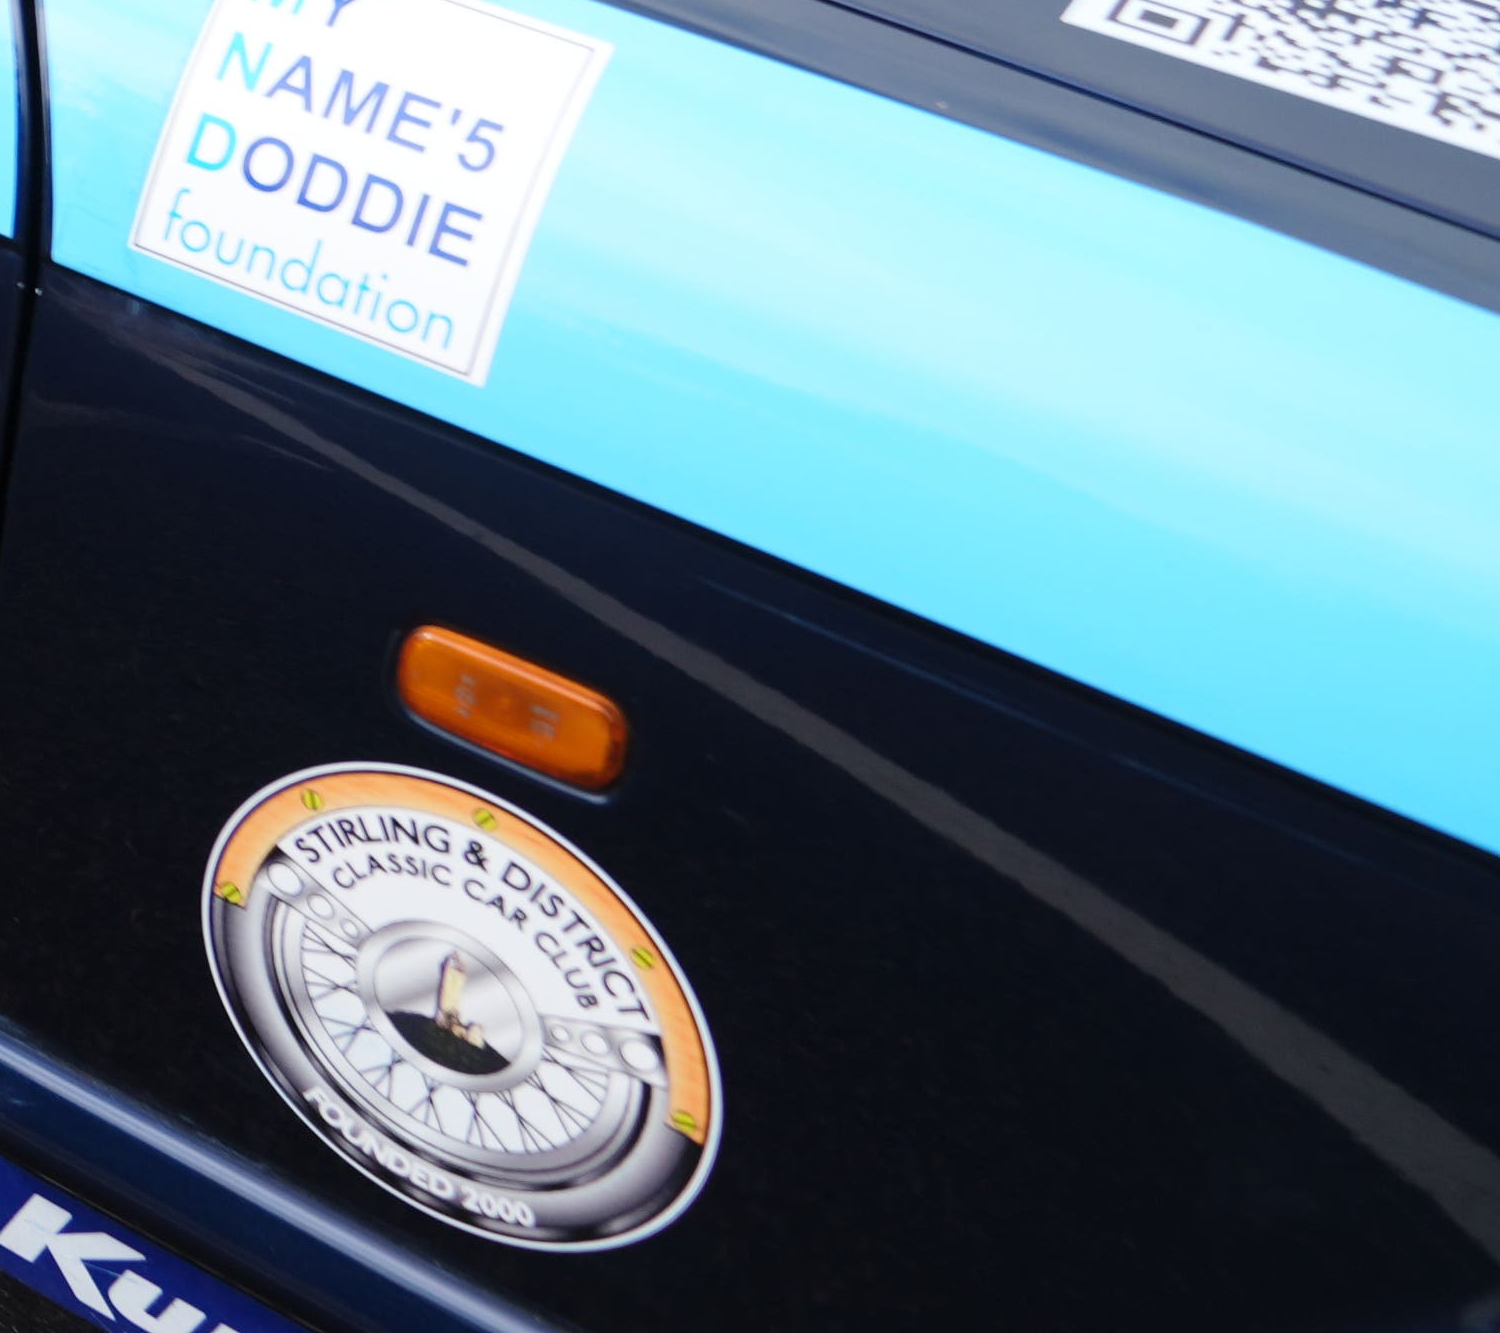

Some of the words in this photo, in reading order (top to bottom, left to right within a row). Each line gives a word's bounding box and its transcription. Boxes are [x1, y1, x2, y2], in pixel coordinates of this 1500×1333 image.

[185, 112, 483, 267] DODDIE
[163, 188, 455, 350] foundation
[294, 814, 451, 865] STIRLING
[463, 839, 488, 872] &
[501, 860, 650, 1022] DISTRICT
[332, 853, 452, 890] CLASSIC
[463, 879, 527, 931] CAR
[535, 931, 601, 1010] CLUB
[301, 1085, 453, 1202] FOUNDED
[461, 1187, 535, 1228] 2000
